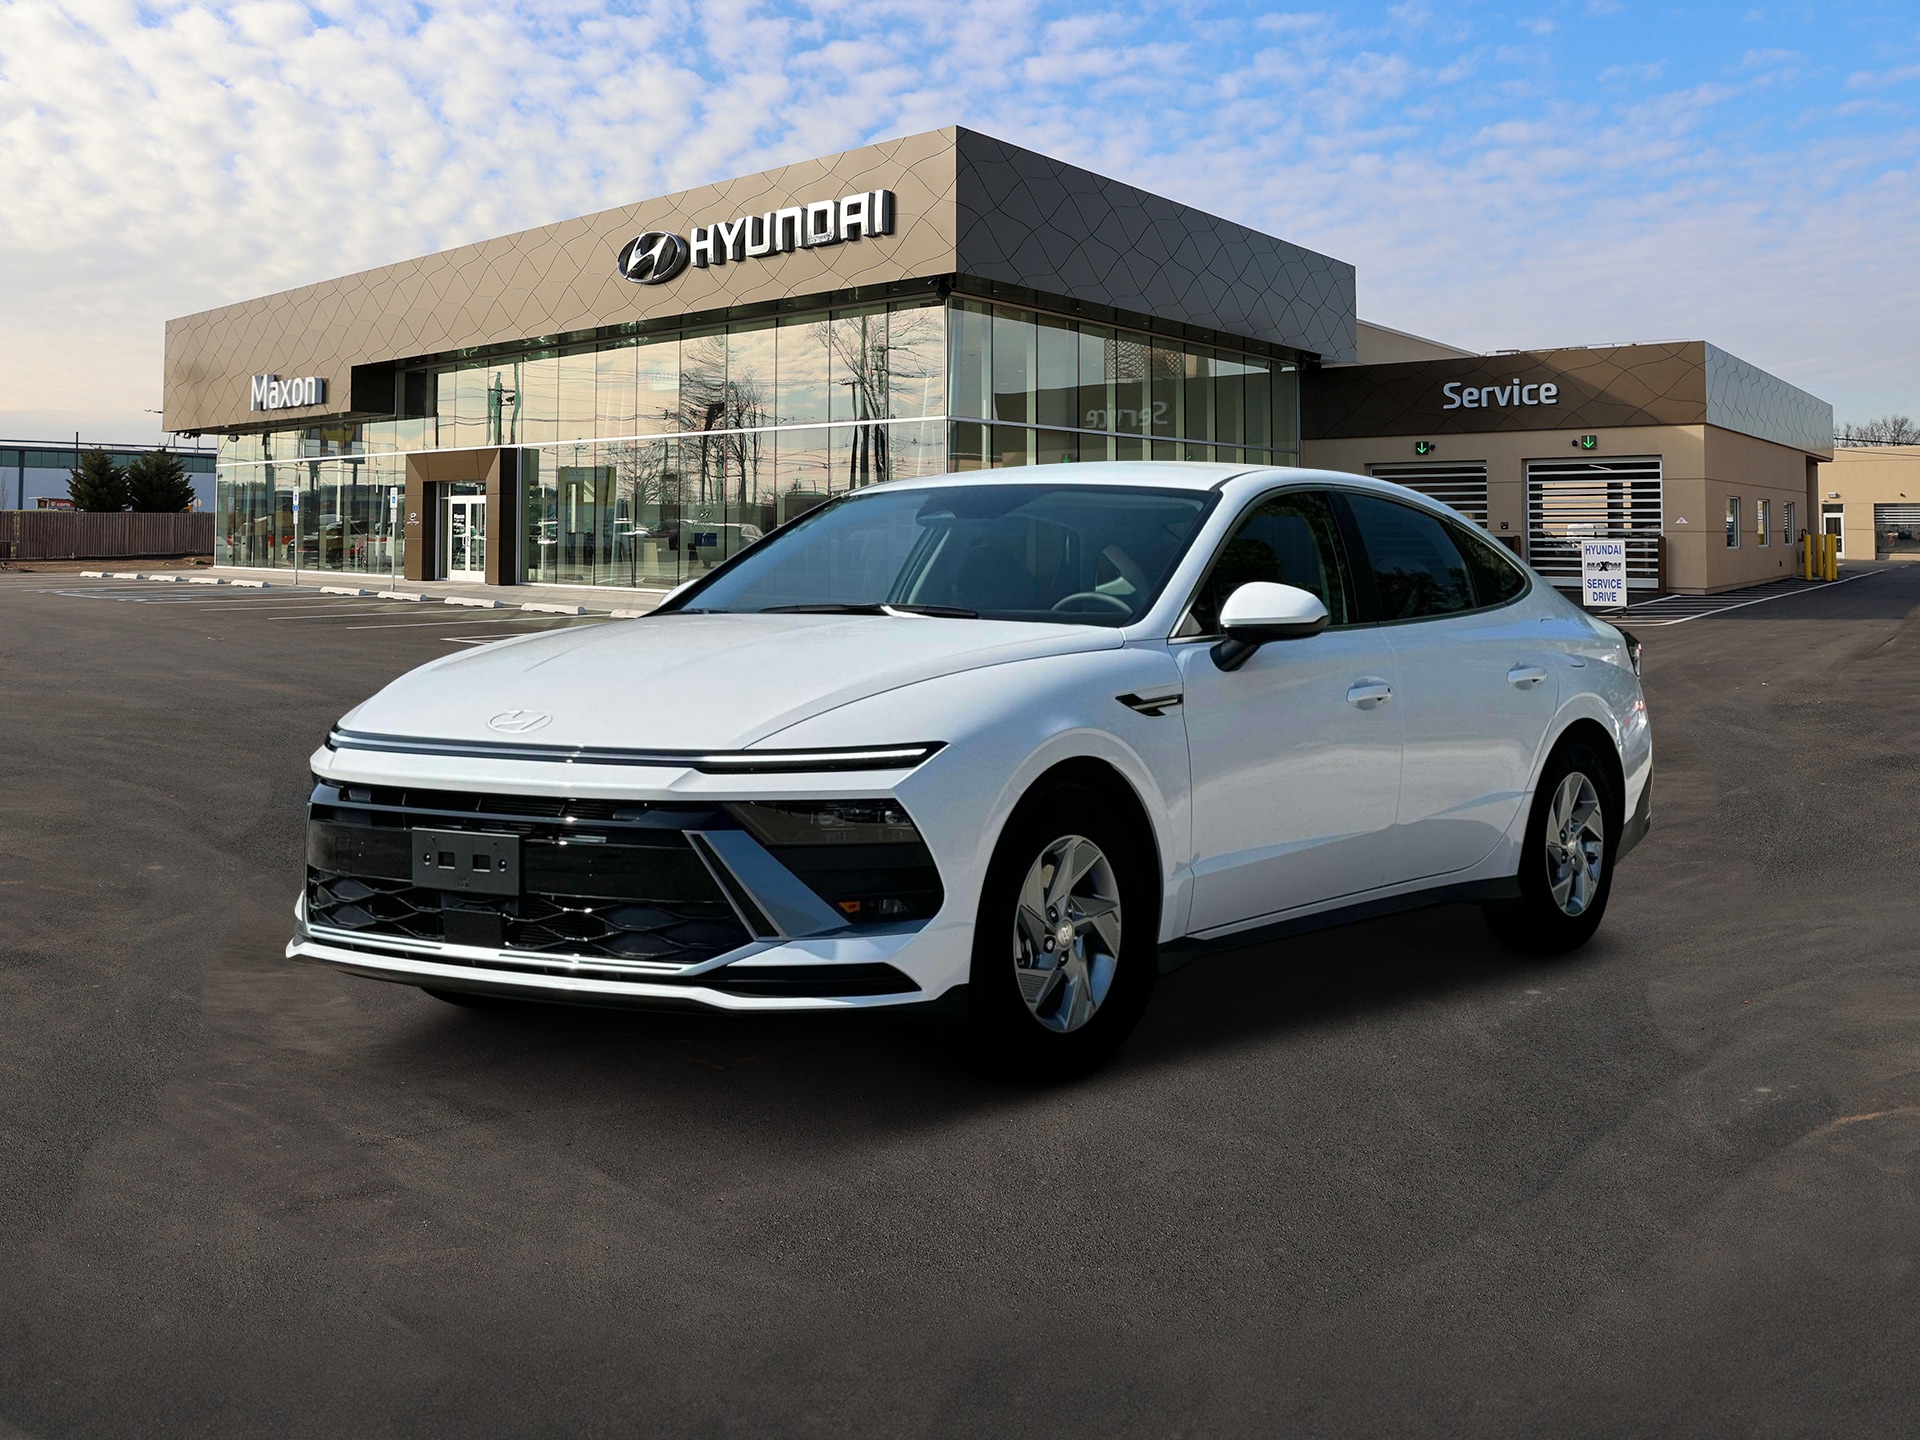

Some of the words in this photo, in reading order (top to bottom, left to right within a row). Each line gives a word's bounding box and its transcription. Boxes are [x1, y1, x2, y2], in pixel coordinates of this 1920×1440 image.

[690, 189, 891, 267] HYUNDAI
[250, 374, 323, 411] Maxon
[1443, 378, 1558, 409] Service
[1585, 545, 1622, 555] HYUNDAI
[1586, 561, 1622, 571] MAXON
[1587, 579, 1622, 589] SERVICE
[1592, 592, 1617, 602] DRIVE
